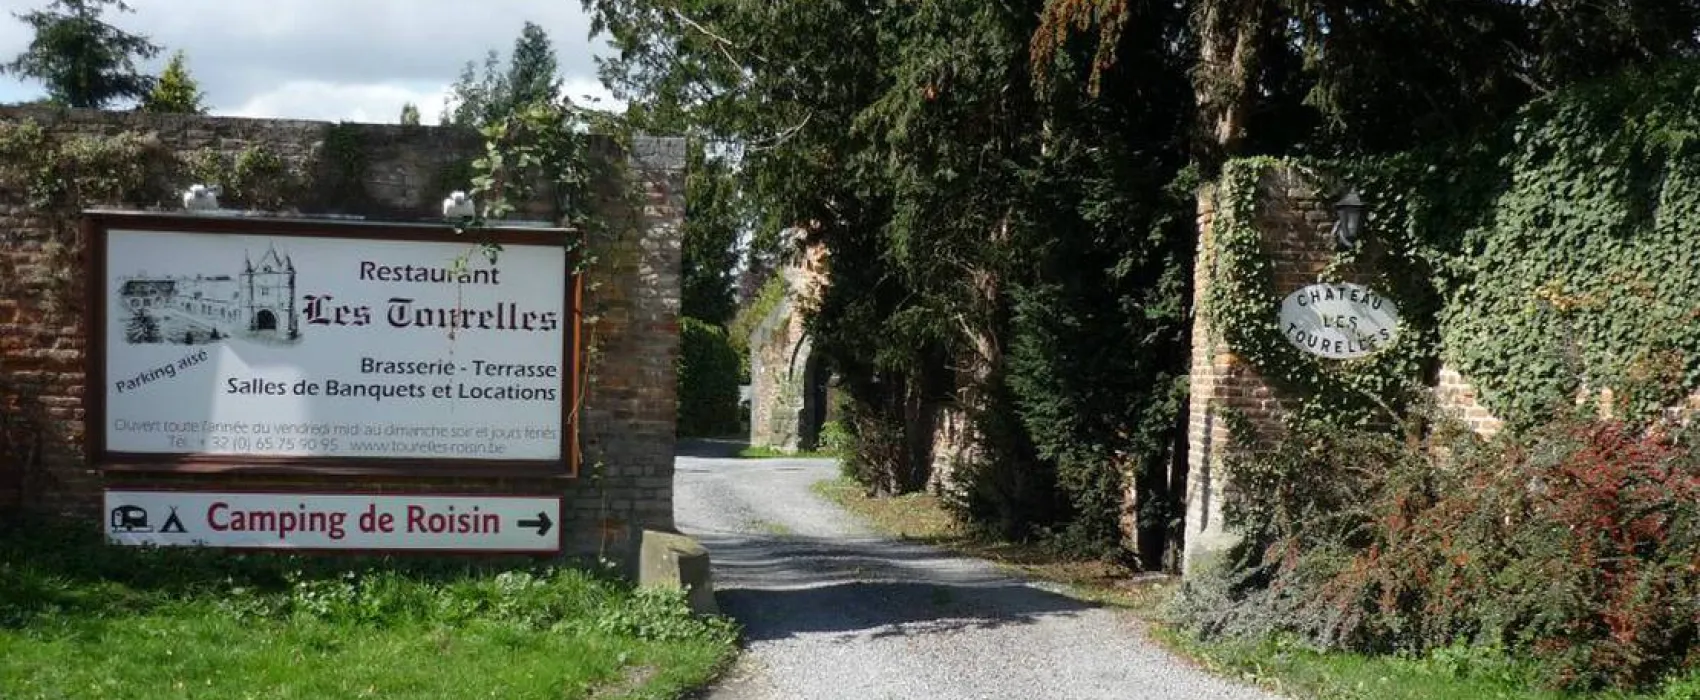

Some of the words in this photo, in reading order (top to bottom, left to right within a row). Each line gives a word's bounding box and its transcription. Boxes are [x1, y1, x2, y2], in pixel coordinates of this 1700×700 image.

[360, 260, 500, 285] Restaurant
[302, 294, 371, 326] Les
[387, 297, 557, 331] Tourelles
[1323, 314, 1358, 329] LES
[115, 363, 176, 393] Parking
[361, 357, 454, 375] Brasserie
[473, 359, 557, 378] Terrasse
[227, 377, 286, 395] Salles
[293, 378, 320, 396] de
[326, 379, 425, 401] Banquets
[432, 382, 452, 398] et
[458, 382, 556, 400] Locations
[207, 502, 346, 539] Camping
[359, 503, 394, 533] de
[406, 504, 500, 534] Roisin
